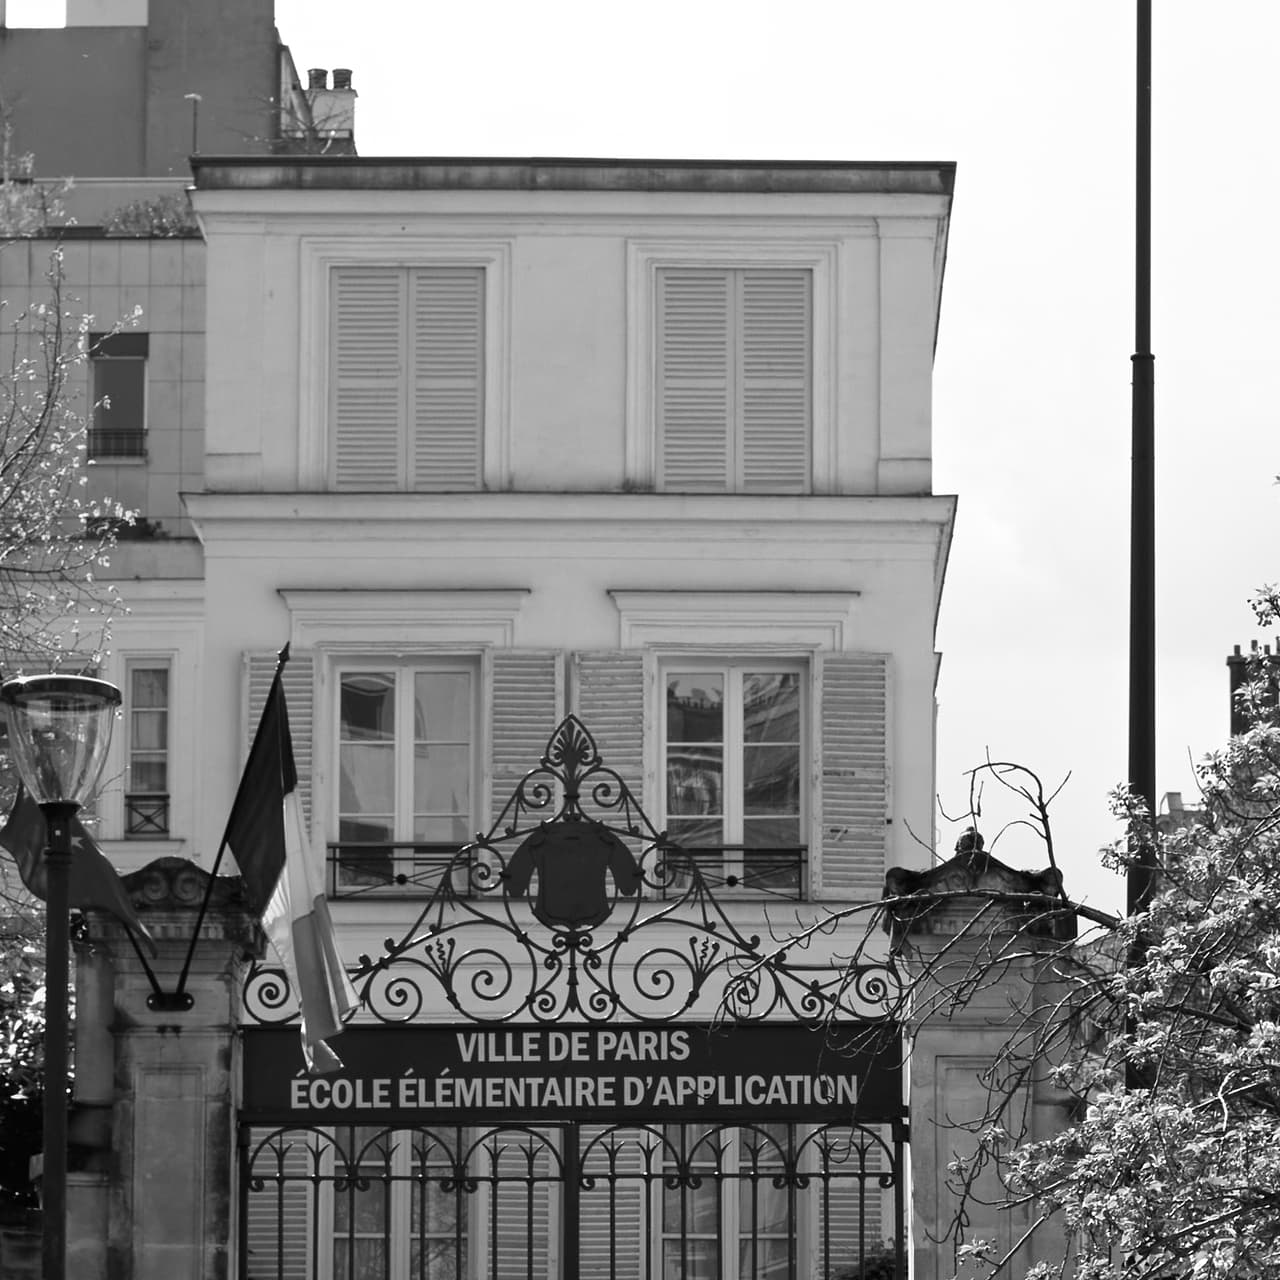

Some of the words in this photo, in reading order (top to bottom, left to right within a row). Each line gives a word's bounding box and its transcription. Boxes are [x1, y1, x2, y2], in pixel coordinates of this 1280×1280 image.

[456, 1032, 541, 1062] VILLE
[548, 1031, 590, 1062] DE
[597, 1030, 691, 1061] PARIS
[290, 1068, 392, 1109] ÉCOLE
[398, 1067, 617, 1108] ÉLÉMENTAIRE
[623, 1074, 859, 1107] D'APPLICATION
